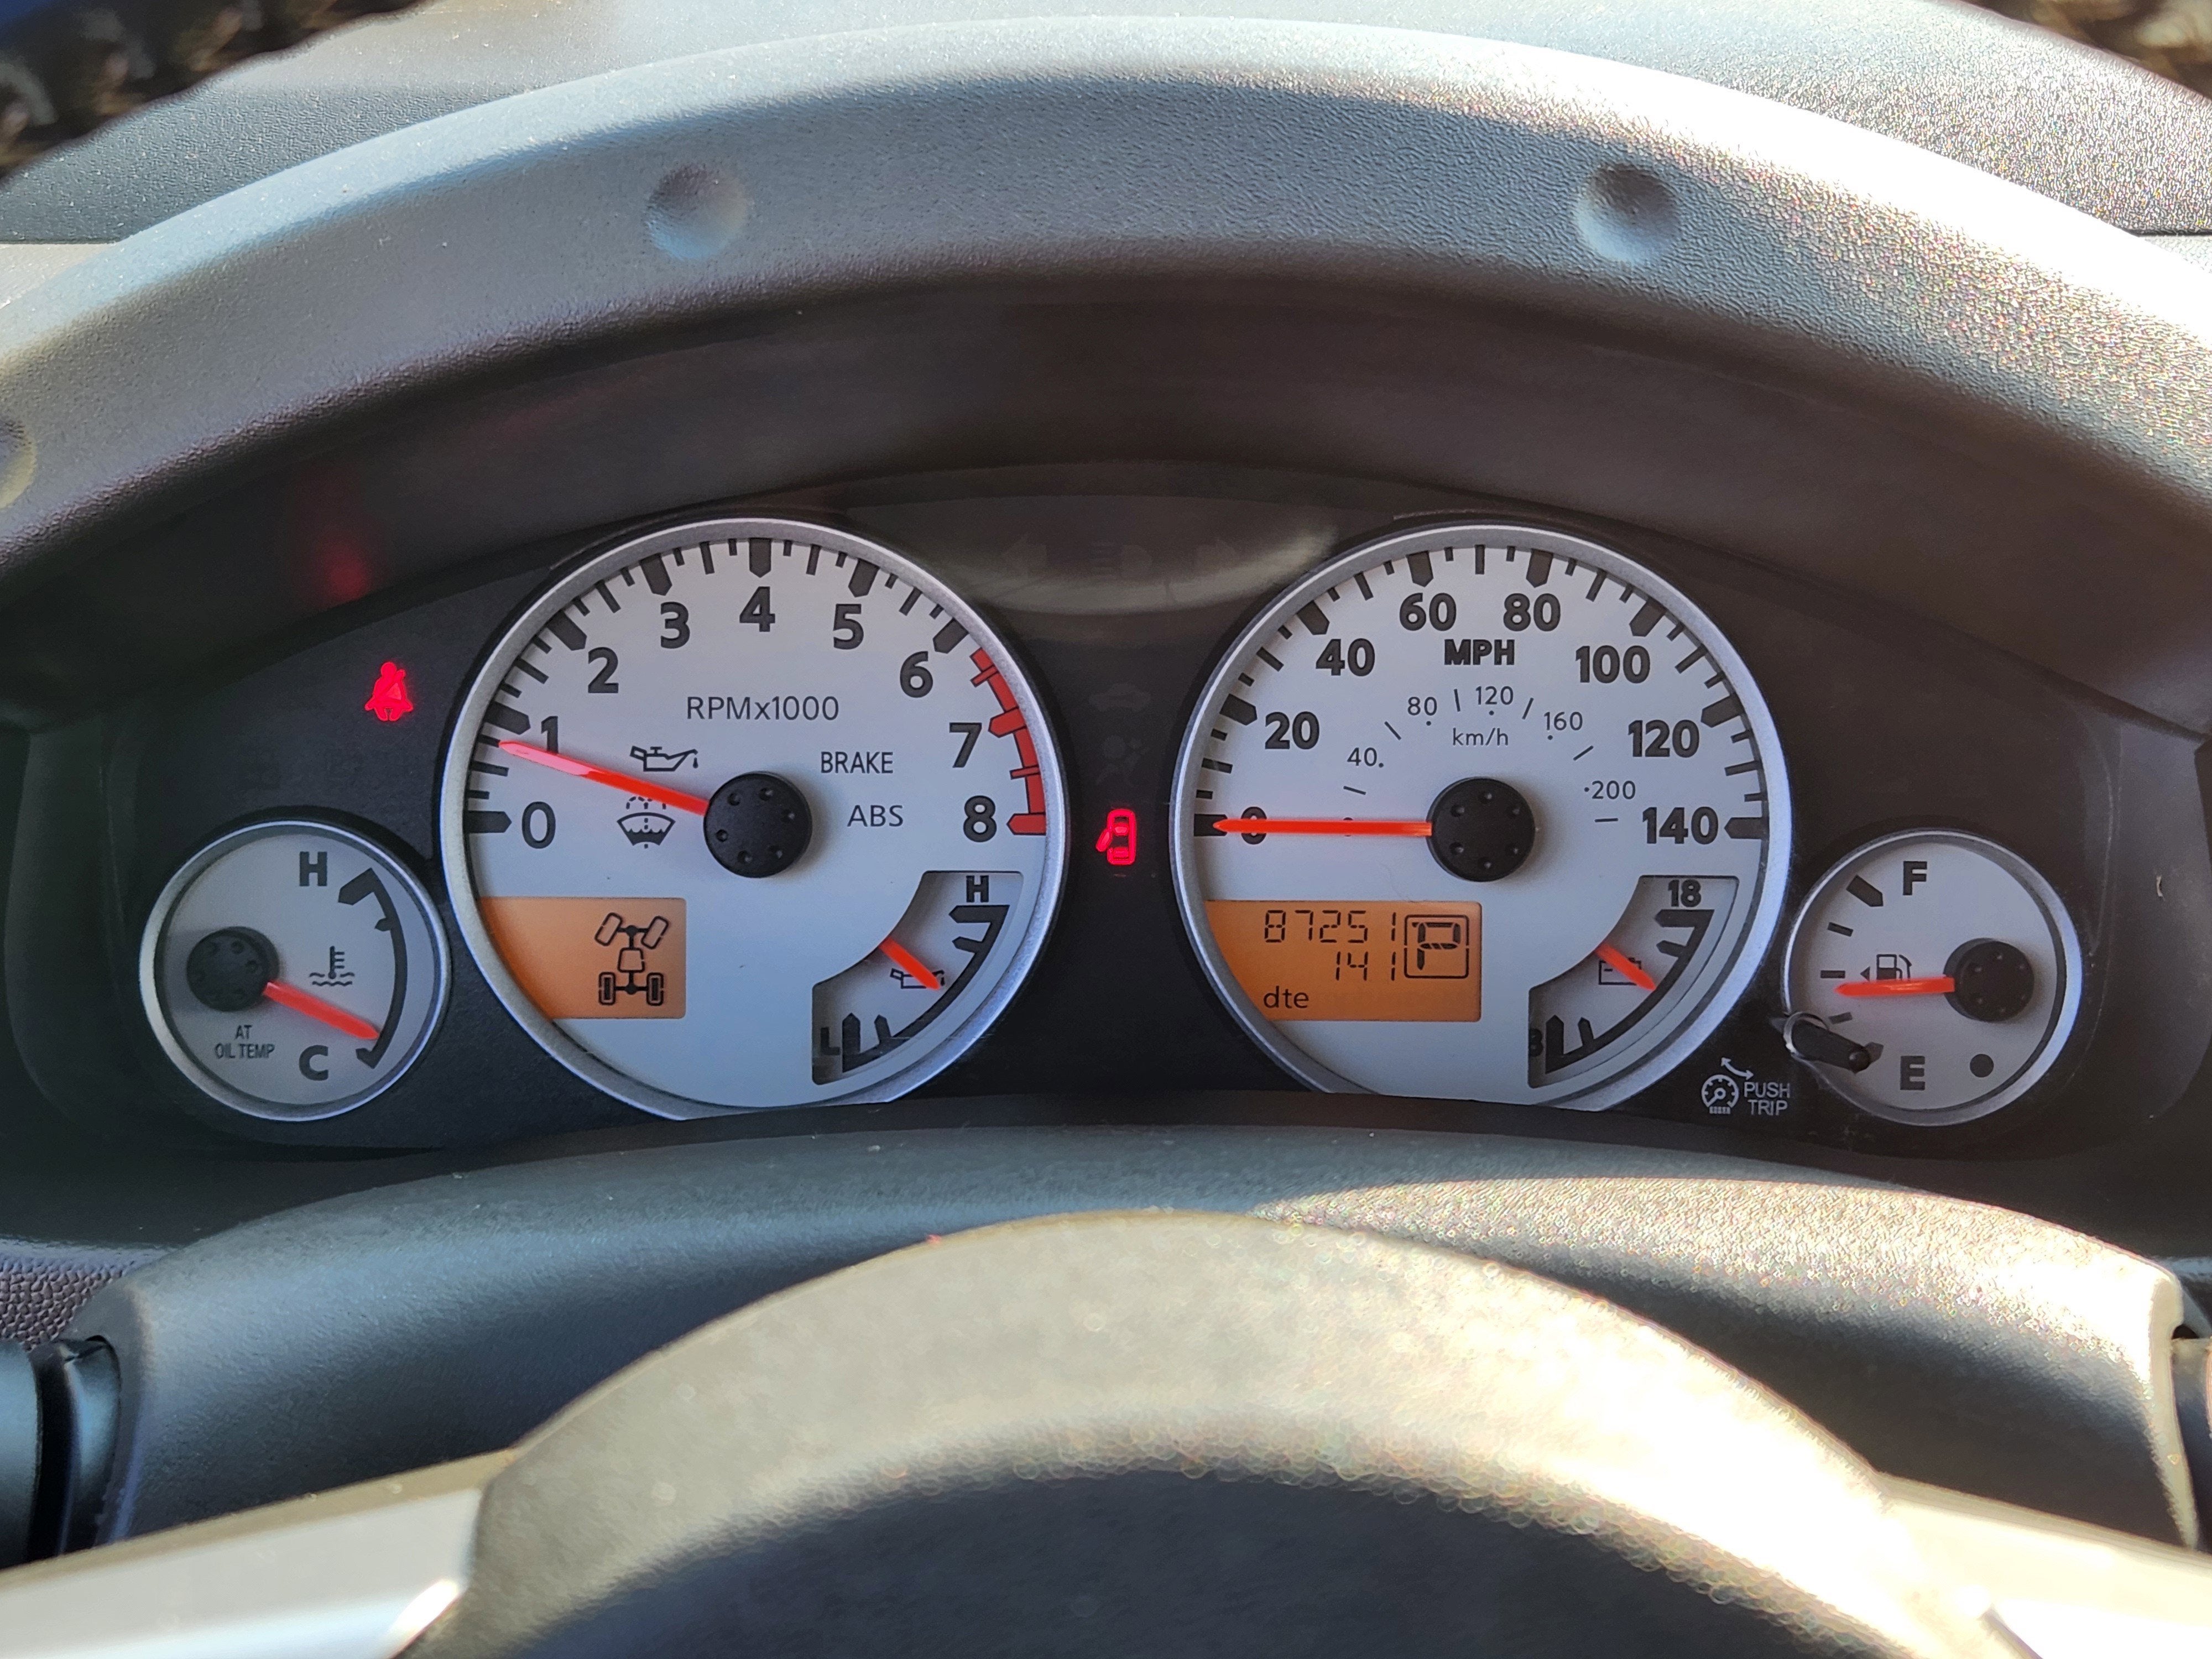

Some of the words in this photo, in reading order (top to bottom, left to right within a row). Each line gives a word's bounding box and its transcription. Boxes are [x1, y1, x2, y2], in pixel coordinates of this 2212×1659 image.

[660, 602, 690, 649] 3
[739, 586, 775, 632] 4
[1399, 593, 1456, 631] 60
[1503, 593, 1561, 632] 80
[833, 604, 864, 649] 5
[1316, 638, 1375, 676] 40
[1444, 639, 1515, 666] MPH
[1576, 645, 1651, 684] 100
[587, 647, 618, 693] 2
[900, 651, 933, 698] 6
[686, 697, 839, 721] RPMx1000
[1407, 697, 1437, 717] 80
[1475, 686, 1514, 707] 120
[541, 716, 559, 755] 1
[1265, 712, 1321, 750] 20
[1452, 727, 1509, 748] km/h
[1544, 712, 1583, 732] 160
[950, 723, 982, 768] 7
[1628, 720, 1699, 759] 120
[821, 752, 893, 774] BRAKE
[1347, 748, 1378, 768] 40
[1591, 781, 1636, 801] 200
[521, 802, 556, 849] 0
[848, 805, 904, 827] ABS
[963, 796, 997, 842] 8
[1642, 807, 1719, 846] 140
[299, 851, 327, 886] H
[1903, 862, 1927, 895] F
[967, 875, 989, 902] H
[1668, 880, 1702, 906] 18
[1264, 910, 1397, 943] 87251
[1411, 922, 1461, 970] P
[1335, 951, 1395, 981] 141
[1264, 986, 1309, 1010] dte
[235, 1025, 252, 1038] AT
[215, 1045, 235, 1059] OIL
[239, 1045, 274, 1058] TEMP
[299, 1045, 328, 1080] C
[1900, 1056, 1925, 1090] E
[1744, 1083, 1790, 1098] PUSH
[1749, 1100, 1787, 1115] TRIP
